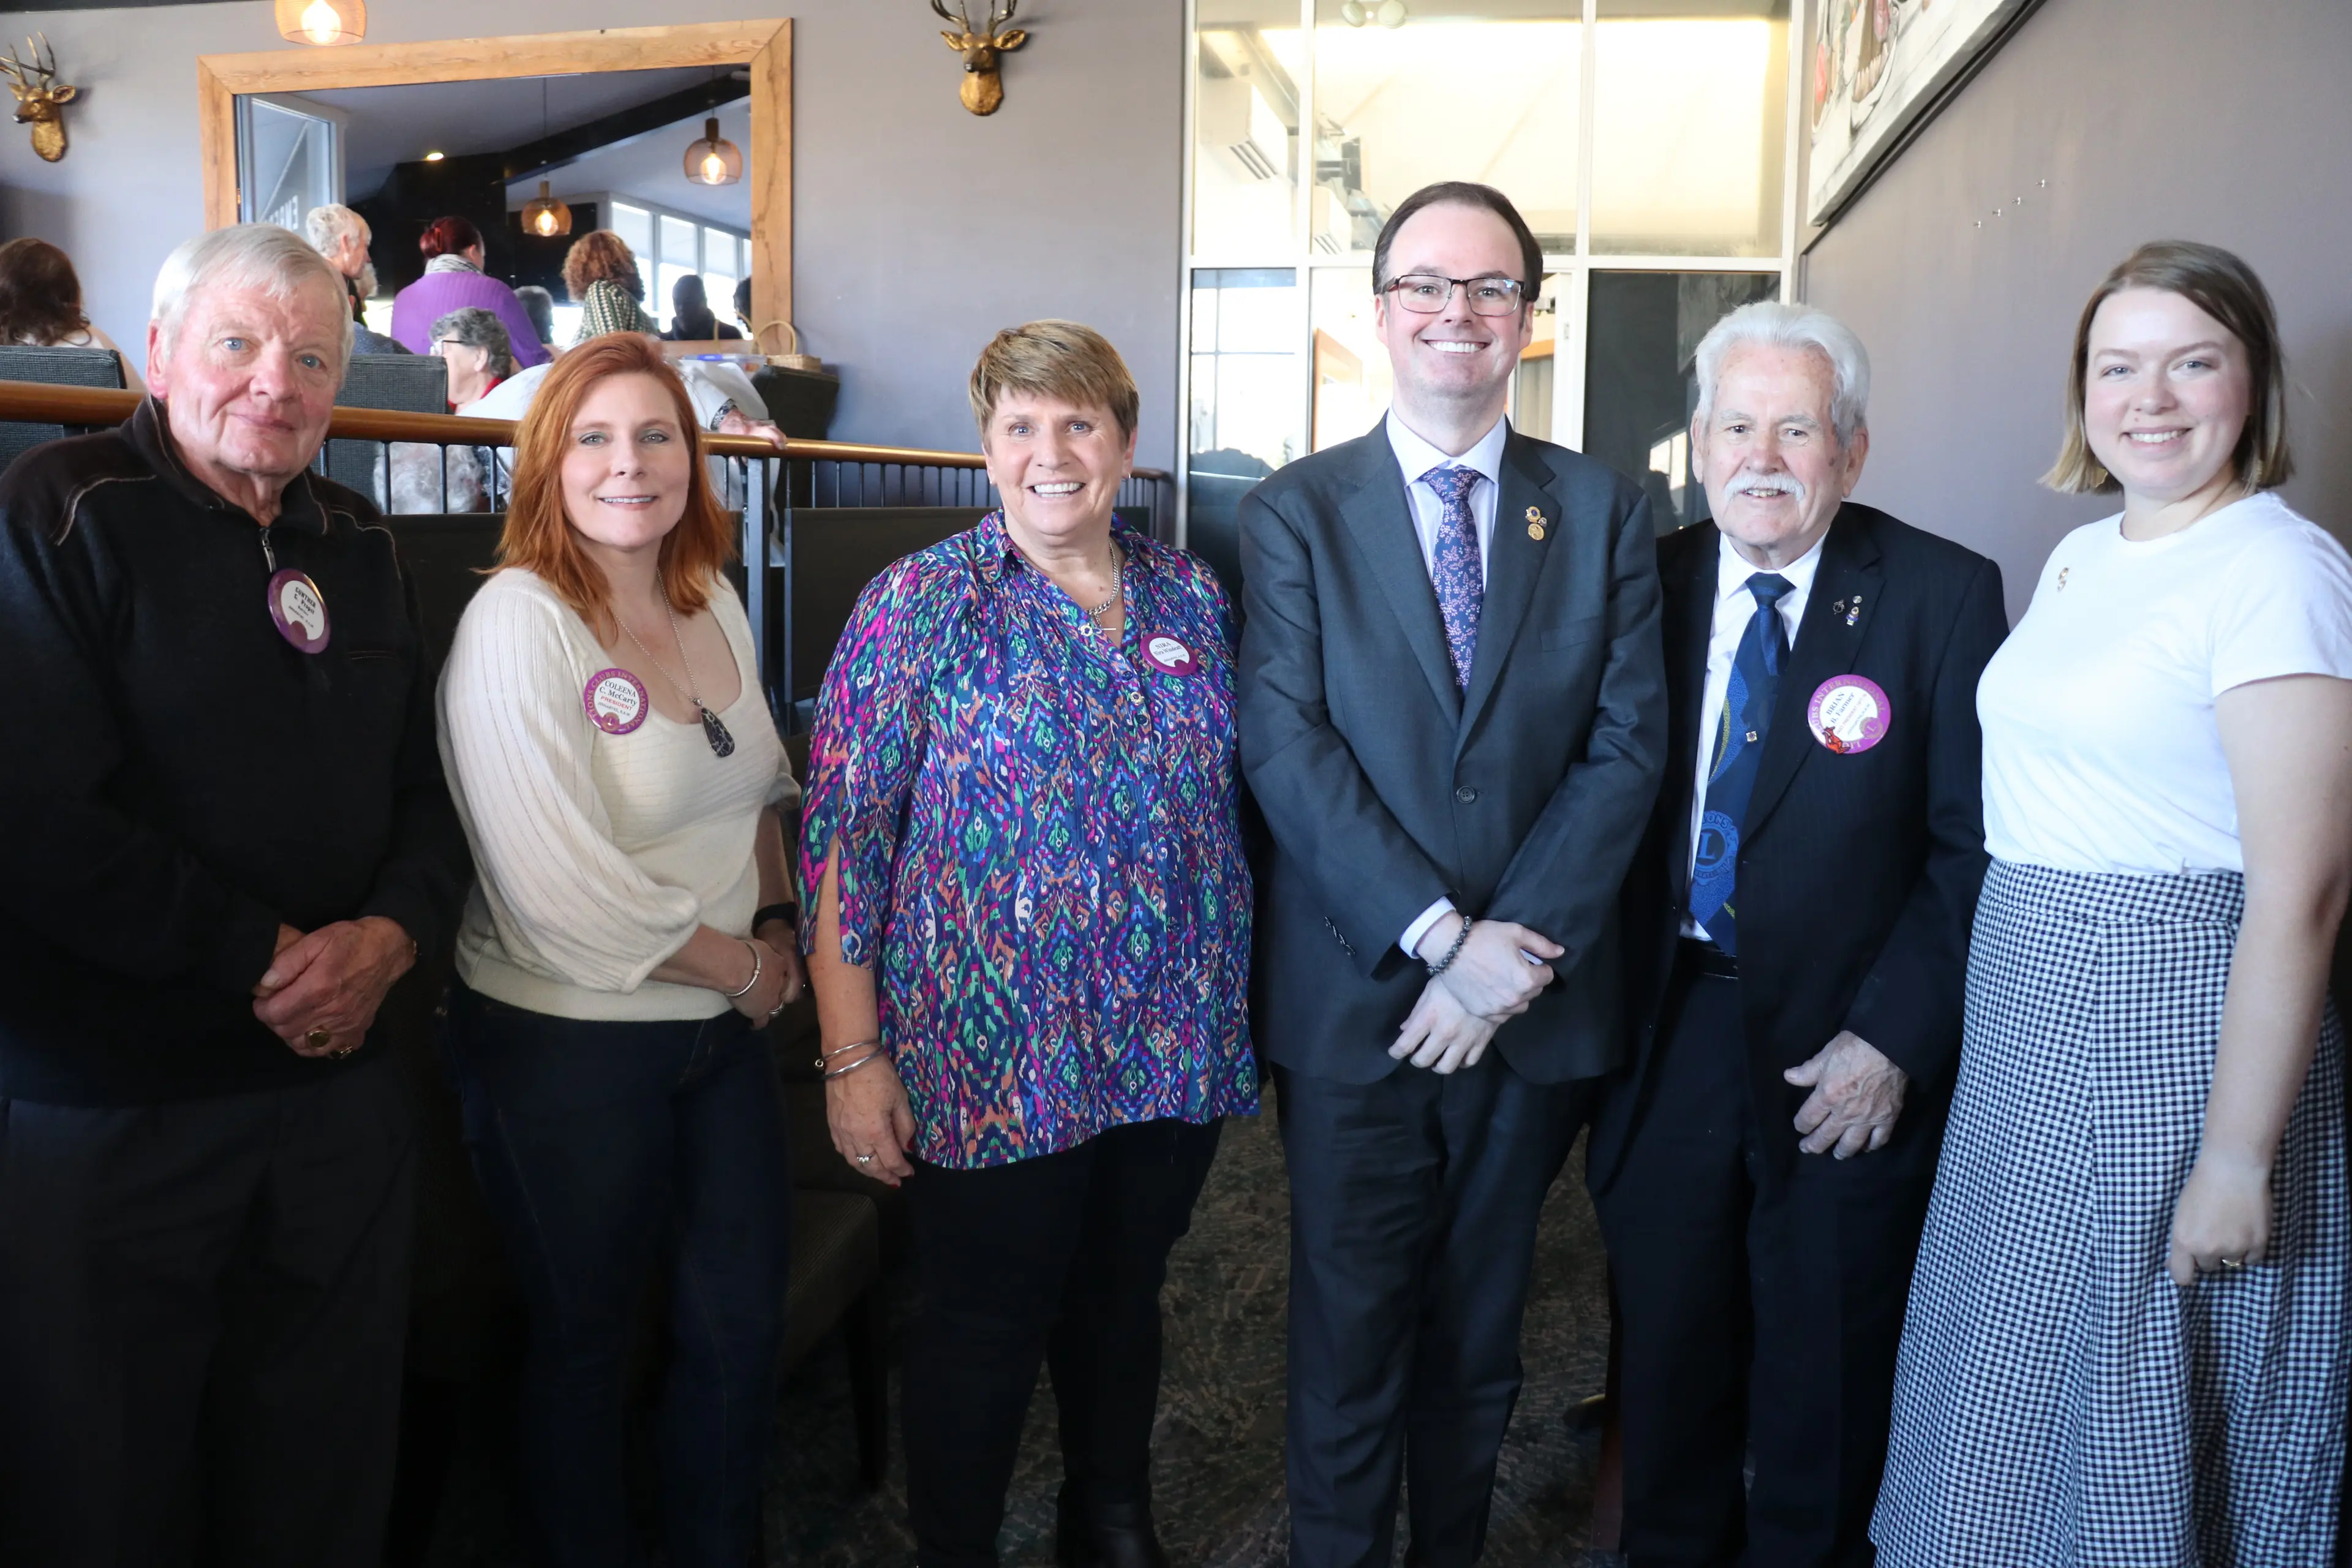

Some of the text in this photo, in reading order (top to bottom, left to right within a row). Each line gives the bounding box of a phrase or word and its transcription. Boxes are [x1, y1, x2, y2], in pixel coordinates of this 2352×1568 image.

[591, 671, 616, 688] CLUBS
[617, 671, 647, 729] INTERNATIONAL
[605, 680, 636, 697] COLEENA
[608, 690, 637, 706] McCarty
[1814, 678, 1886, 713] INTERNATIONAL
[601, 696, 632, 710] PRESIDENT
[1826, 692, 1845, 715] BRIAN
[1835, 692, 1855, 717] Farmer
[1698, 833, 1716, 859] L
